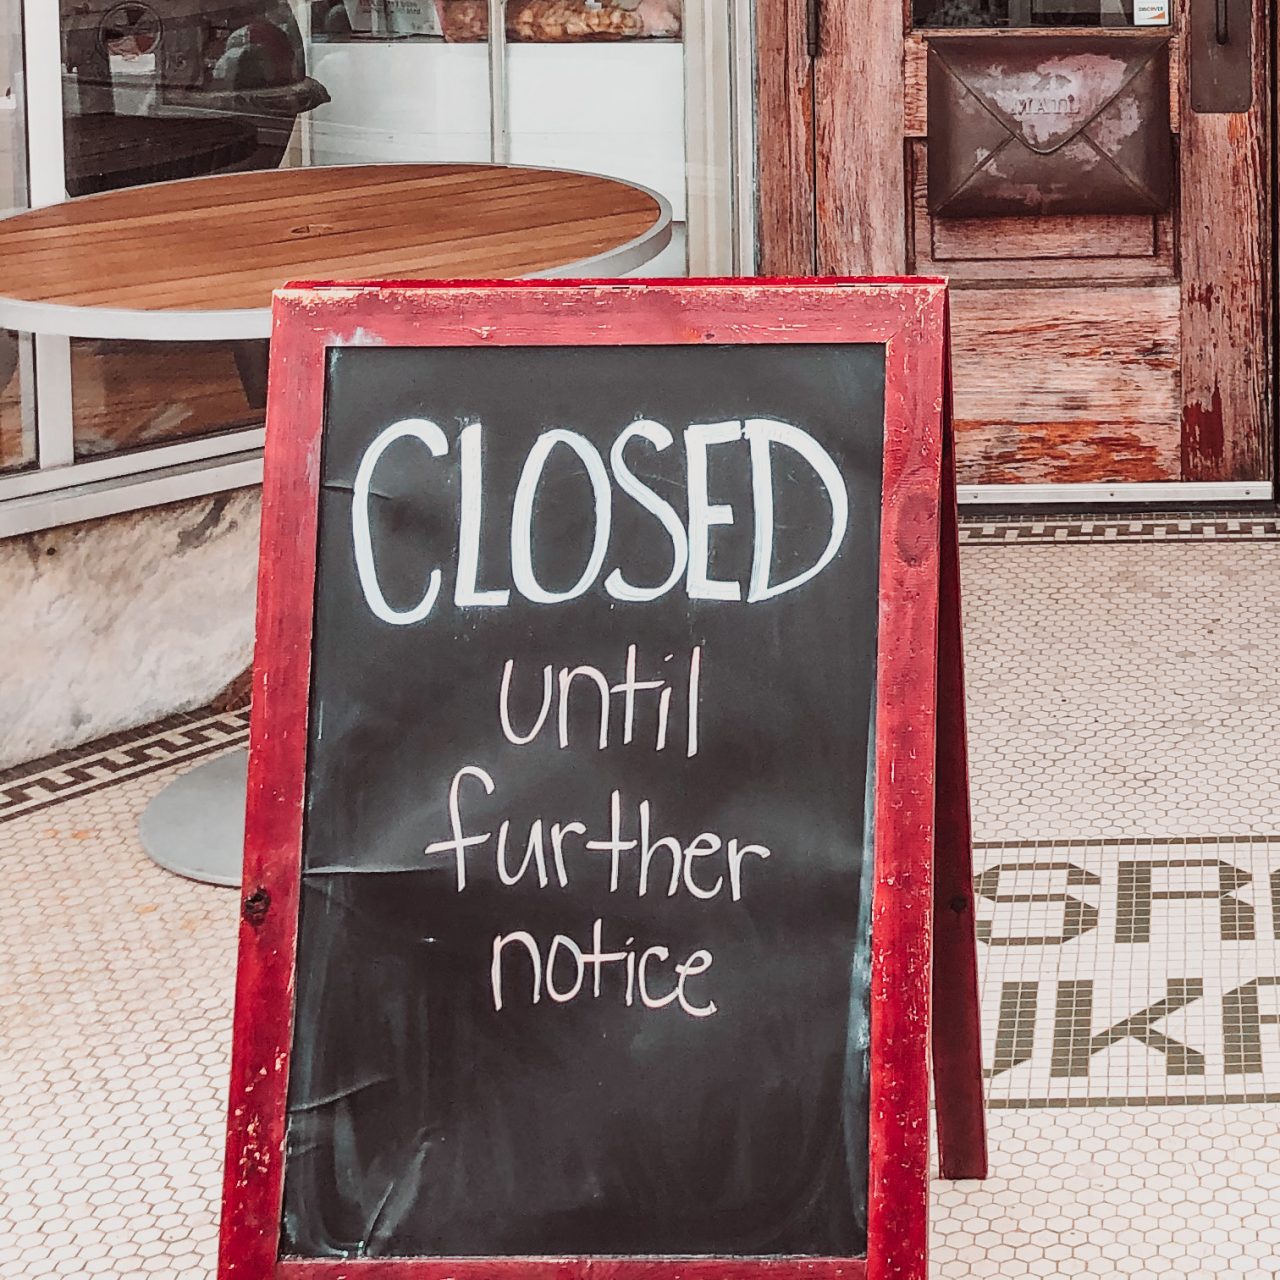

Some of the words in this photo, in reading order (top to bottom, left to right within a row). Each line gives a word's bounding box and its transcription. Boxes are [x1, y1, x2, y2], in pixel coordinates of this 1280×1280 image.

[352, 417, 848, 625] CLOSED
[499, 644, 701, 757] until
[425, 766, 771, 902] further
[490, 918, 717, 1017] notice
